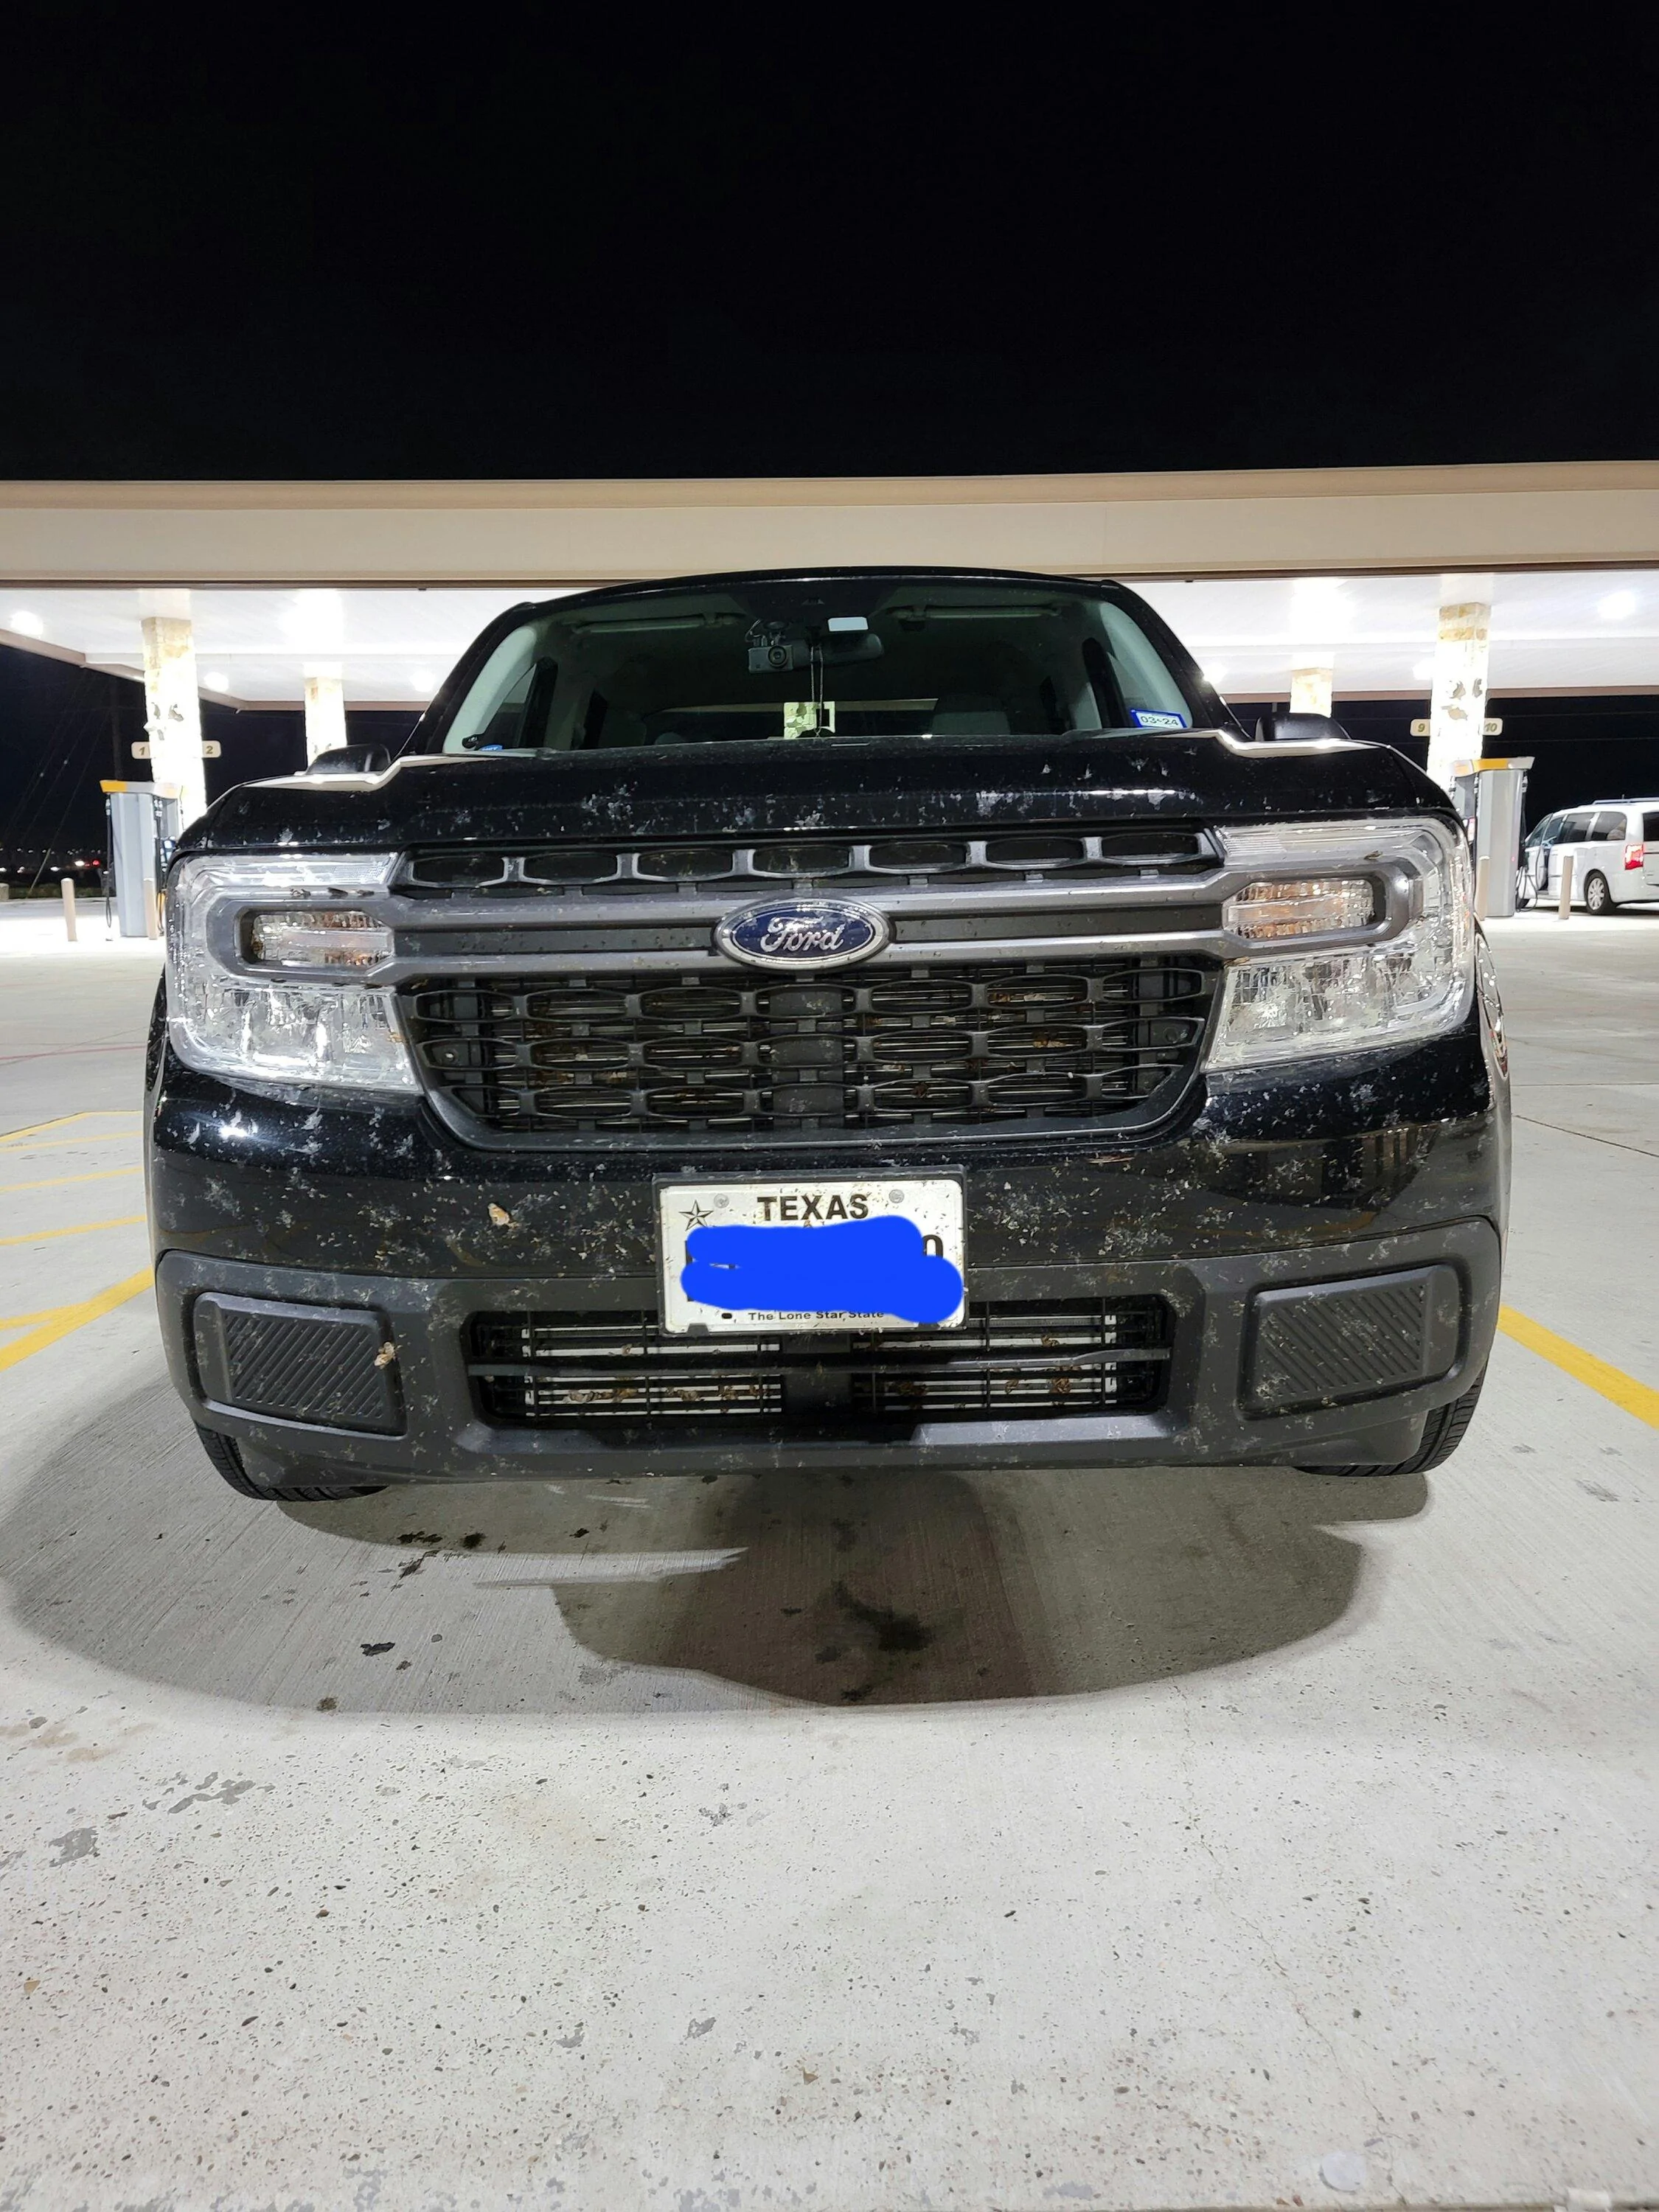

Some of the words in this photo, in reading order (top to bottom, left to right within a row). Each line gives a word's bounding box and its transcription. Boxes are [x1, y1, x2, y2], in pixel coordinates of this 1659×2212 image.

[1417, 723, 1425, 732] 9
[1484, 723, 1498, 732] 10
[139, 746, 146, 756] 1
[206, 745, 214, 754] 2
[759, 917, 847, 953] Ford
[757, 1193, 869, 1221] TEXAS
[748, 1312, 774, 1321] The
[779, 1311, 812, 1320] Lone
[815, 1310, 847, 1319] Star
[849, 1310, 885, 1319] State
